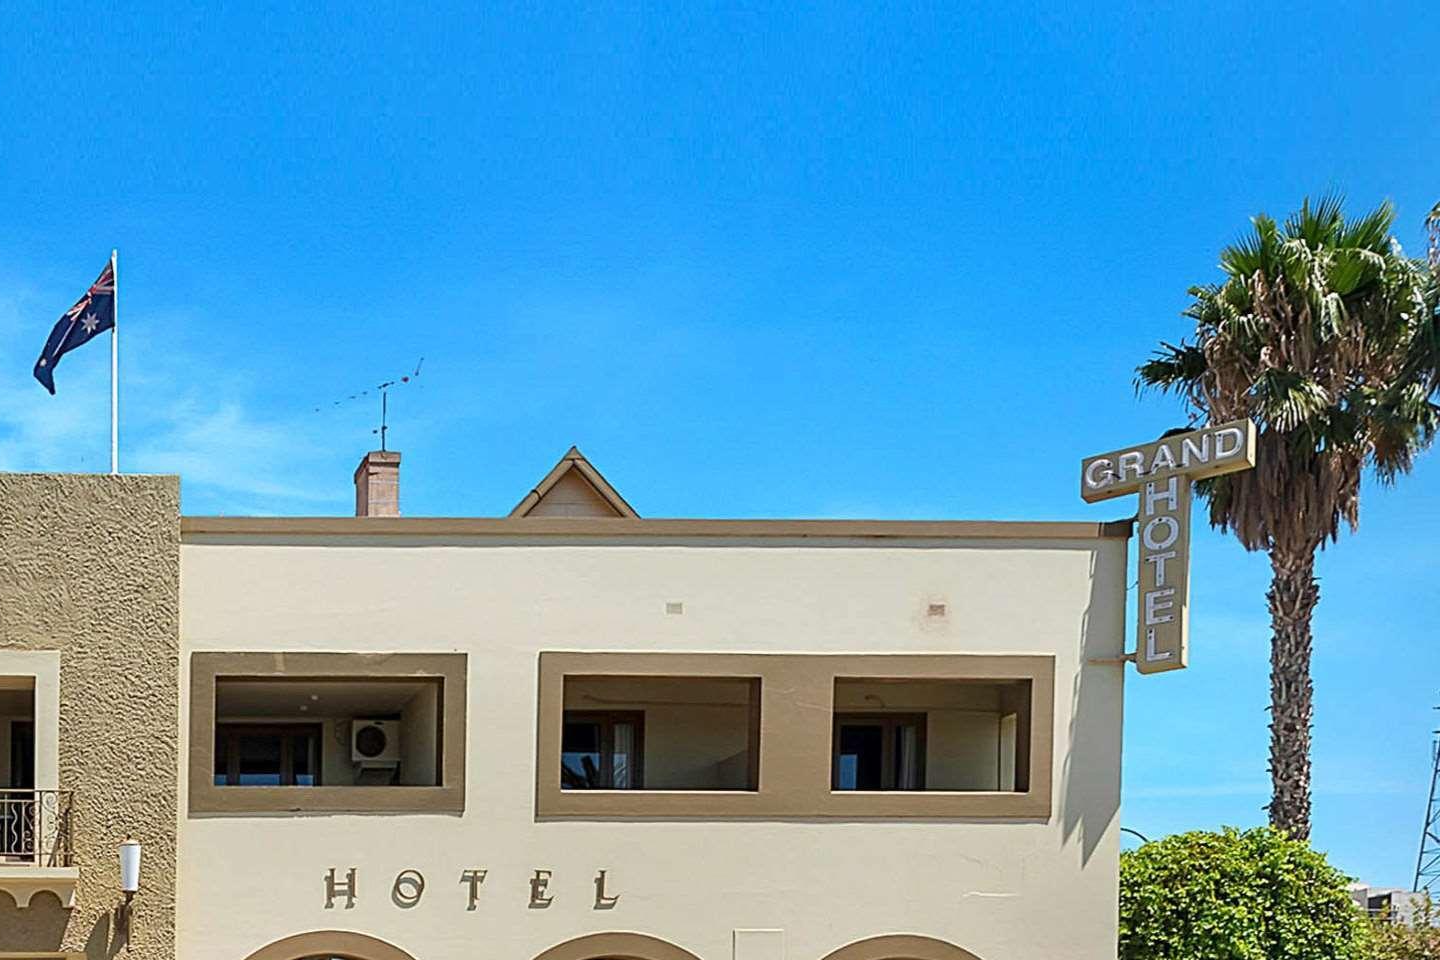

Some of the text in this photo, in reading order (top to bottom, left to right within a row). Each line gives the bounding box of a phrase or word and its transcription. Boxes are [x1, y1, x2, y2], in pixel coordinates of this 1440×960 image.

[1085, 427, 1244, 490] GRAND
[1142, 477, 1180, 662] HOTEL
[325, 867, 620, 903] HOTEL
